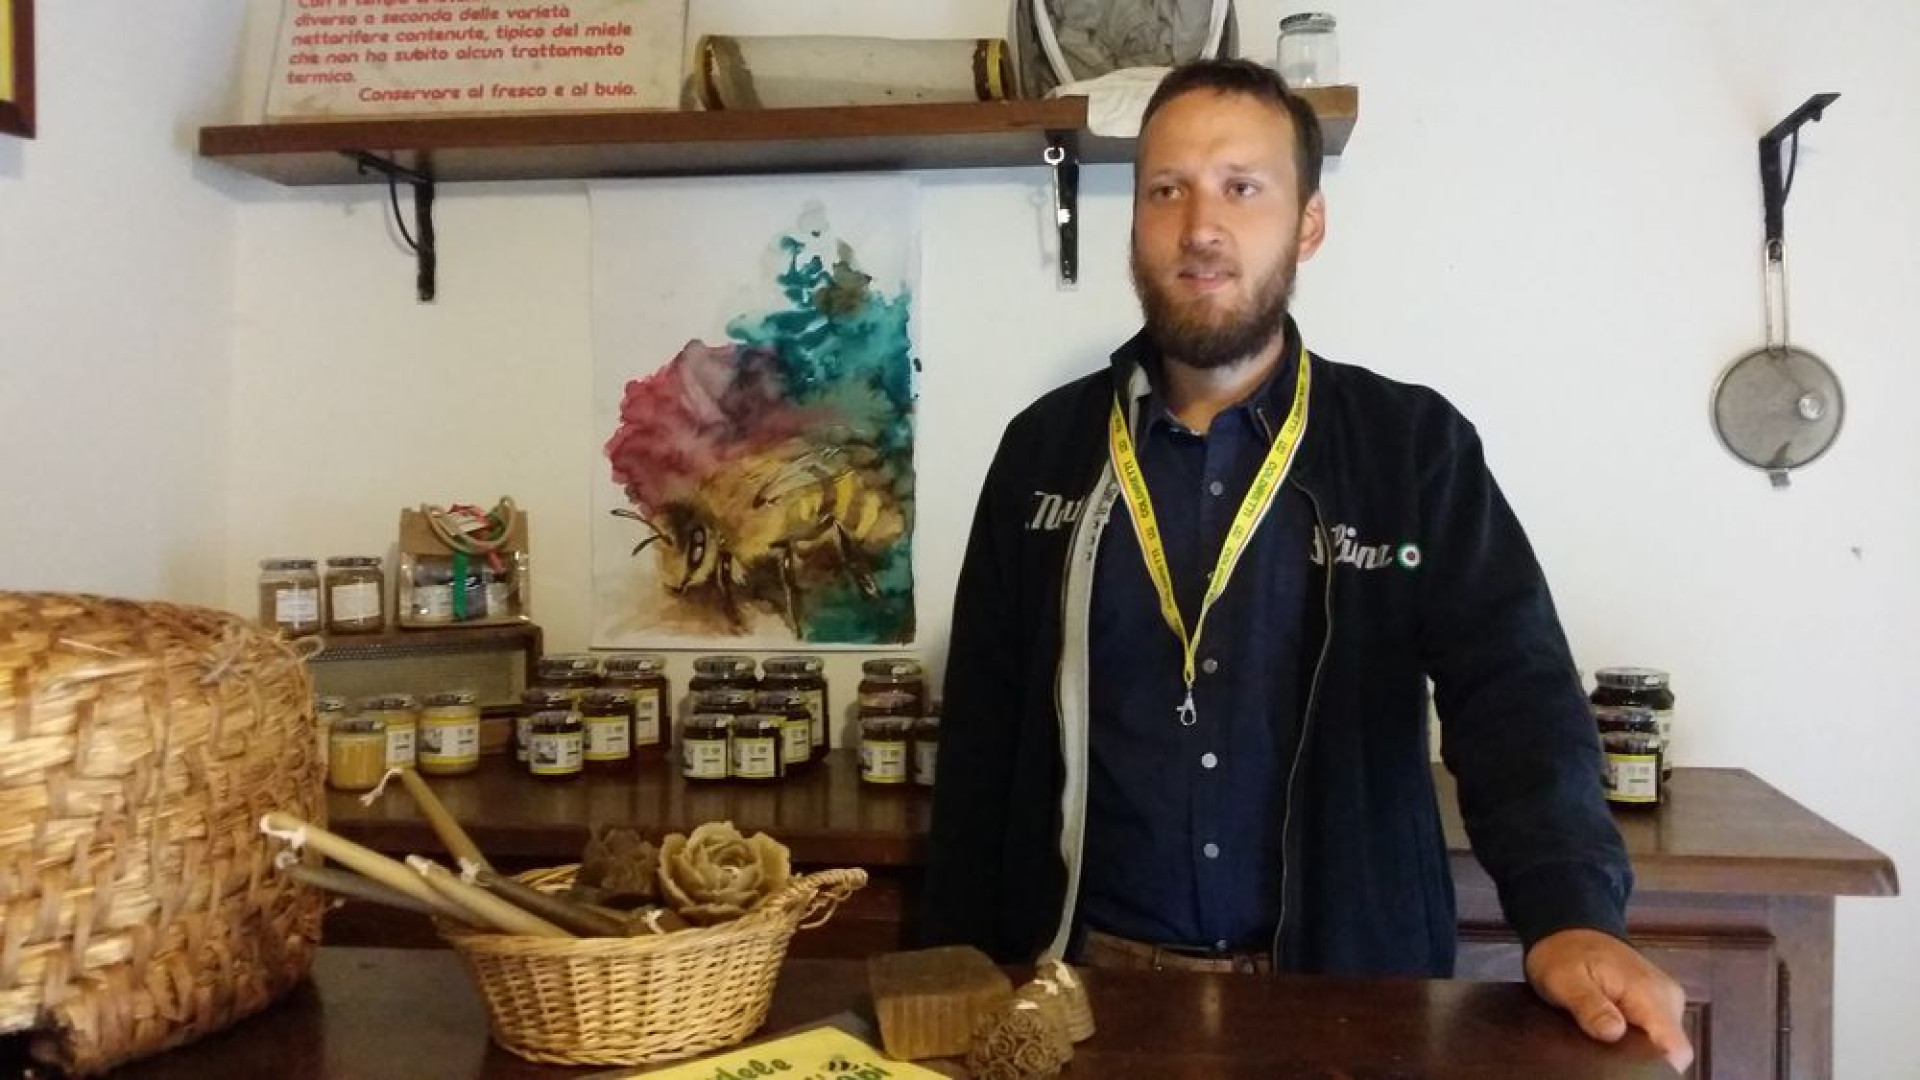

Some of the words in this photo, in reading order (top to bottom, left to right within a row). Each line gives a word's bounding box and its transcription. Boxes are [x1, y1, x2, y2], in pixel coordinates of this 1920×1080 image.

[294, 12, 357, 27] diverso
[364, 14, 375, 25] a
[382, 10, 452, 24] seconda
[460, 6, 500, 21] delle
[507, 4, 571, 19] varietà
[291, 30, 389, 45] nettarifere
[396, 26, 489, 43] contenute,
[496, 24, 545, 42] tipico
[553, 22, 579, 38] del
[585, 20, 632, 37] miele
[289, 53, 319, 65] che
[326, 52, 358, 63] non
[366, 49, 387, 62] ha
[395, 47, 449, 61] subito
[457, 46, 503, 60] alcun
[512, 42, 626, 58] trattamento
[287, 70, 356, 84] termico.
[358, 86, 460, 101] Conservare
[468, 84, 484, 99] al
[491, 83, 547, 98] fresco
[554, 85, 564, 97] e
[571, 82, 588, 97] al
[594, 81, 637, 97] buio.
